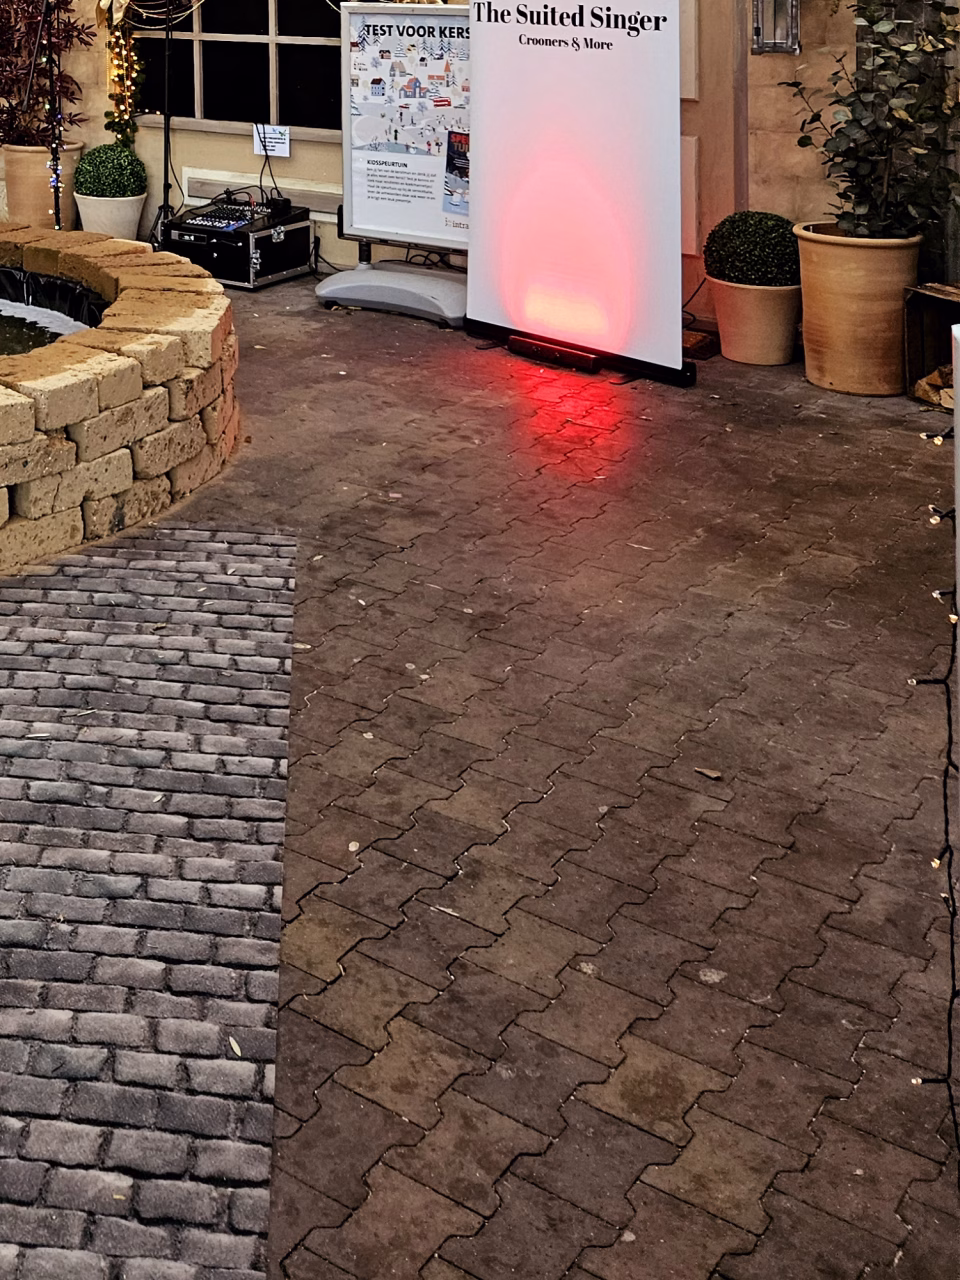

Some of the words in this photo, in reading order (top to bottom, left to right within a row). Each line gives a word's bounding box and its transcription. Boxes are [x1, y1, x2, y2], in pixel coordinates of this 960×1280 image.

[473, 1, 511, 23] The
[516, 3, 584, 27] Suited
[590, 6, 667, 38] Singer
[364, 24, 394, 36] TEST
[396, 25, 436, 38] VOOR
[518, 33, 569, 48] Crooners
[571, 37, 581, 52] &
[583, 37, 614, 51] More
[366, 159, 408, 169] KIDSSPEURTUIN
